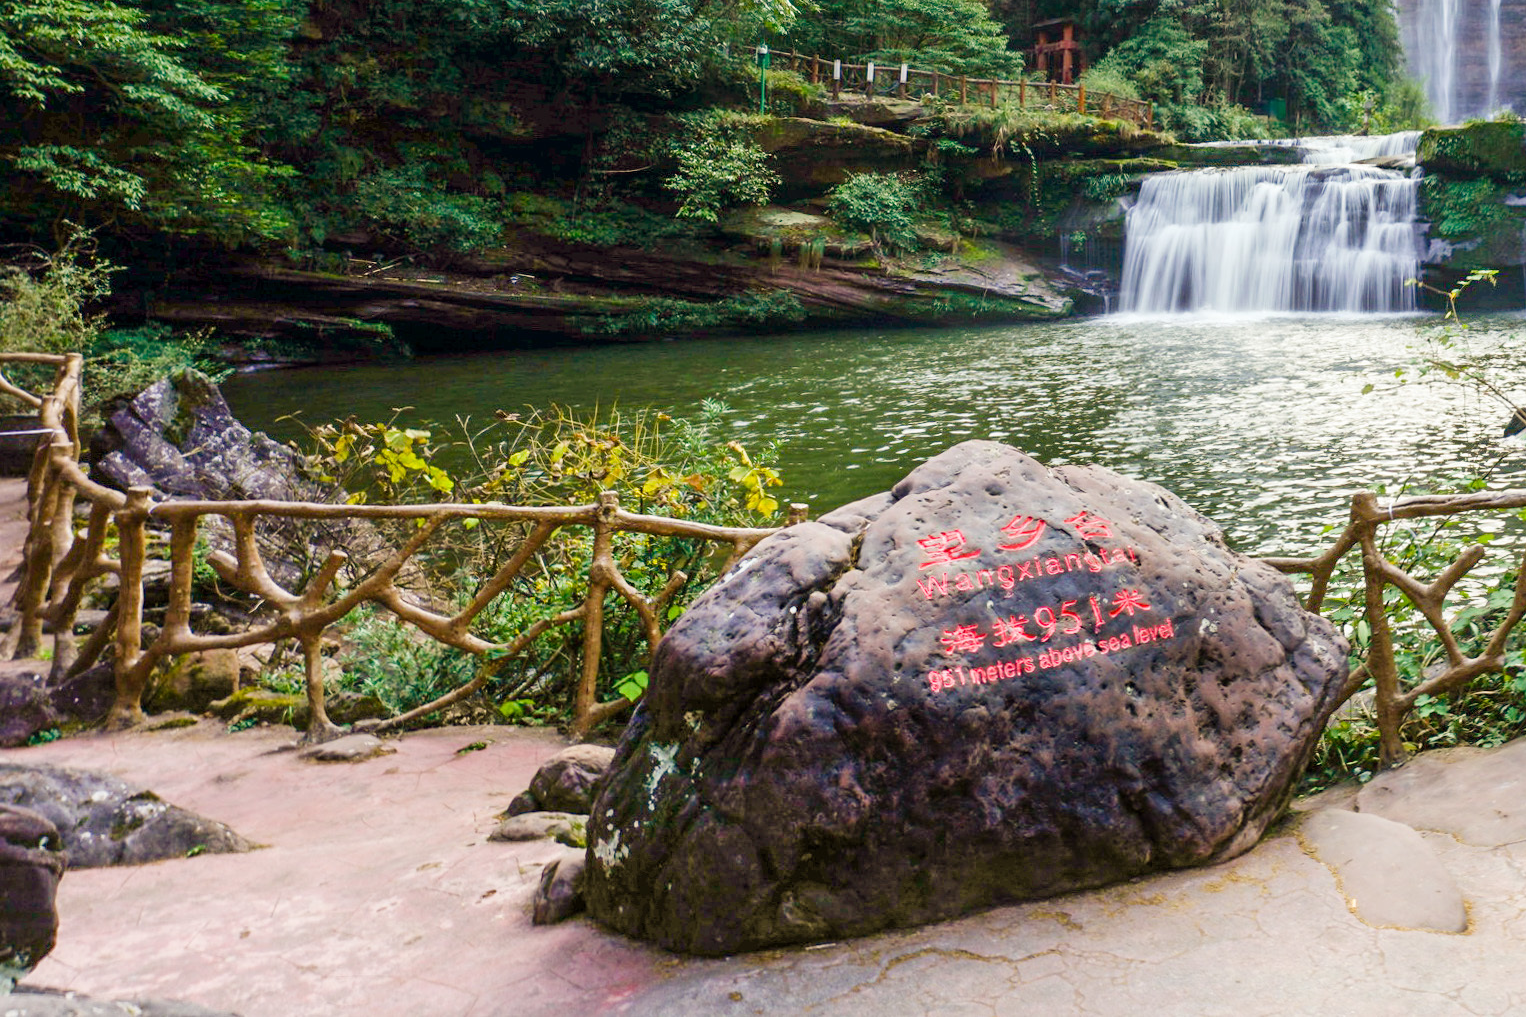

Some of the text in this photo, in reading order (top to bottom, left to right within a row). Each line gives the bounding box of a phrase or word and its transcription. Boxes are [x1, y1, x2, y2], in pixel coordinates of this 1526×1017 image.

[916, 510, 1114, 571] 望乡台
[916, 545, 1137, 600] Wangxiangtai
[940, 588, 1151, 655] 海拔951米
[927, 617, 1174, 693] 951 meters above sea level
